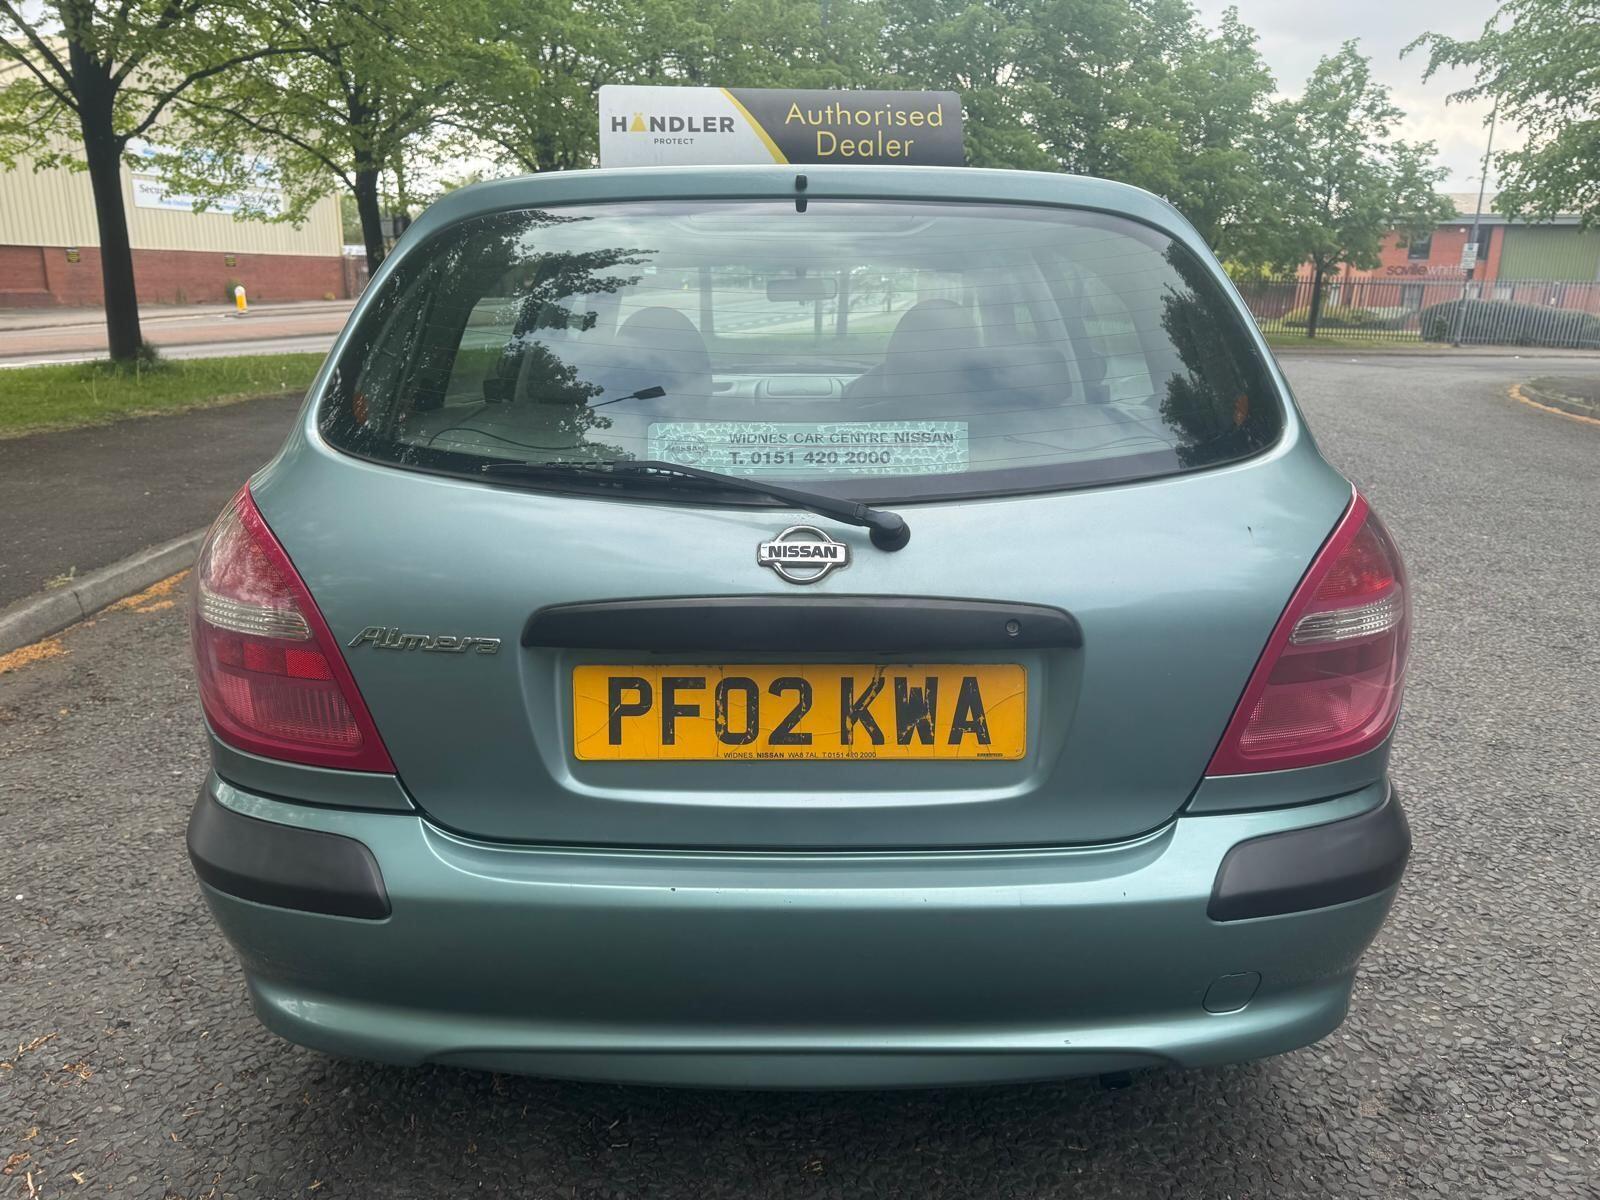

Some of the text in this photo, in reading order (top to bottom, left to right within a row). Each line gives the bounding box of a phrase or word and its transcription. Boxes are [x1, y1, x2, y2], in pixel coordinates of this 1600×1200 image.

[785, 102, 943, 127] Authorised
[816, 131, 914, 157] Dealer
[728, 433, 788, 444] WIDNES
[793, 432, 825, 444] CAR
[893, 431, 954, 444] NISSAN
[730, 451, 891, 464] T. 0151 420 2000
[768, 545, 837, 558] NISSAN
[347, 626, 502, 654] Almera
[608, 676, 992, 746] PF02 KWA
